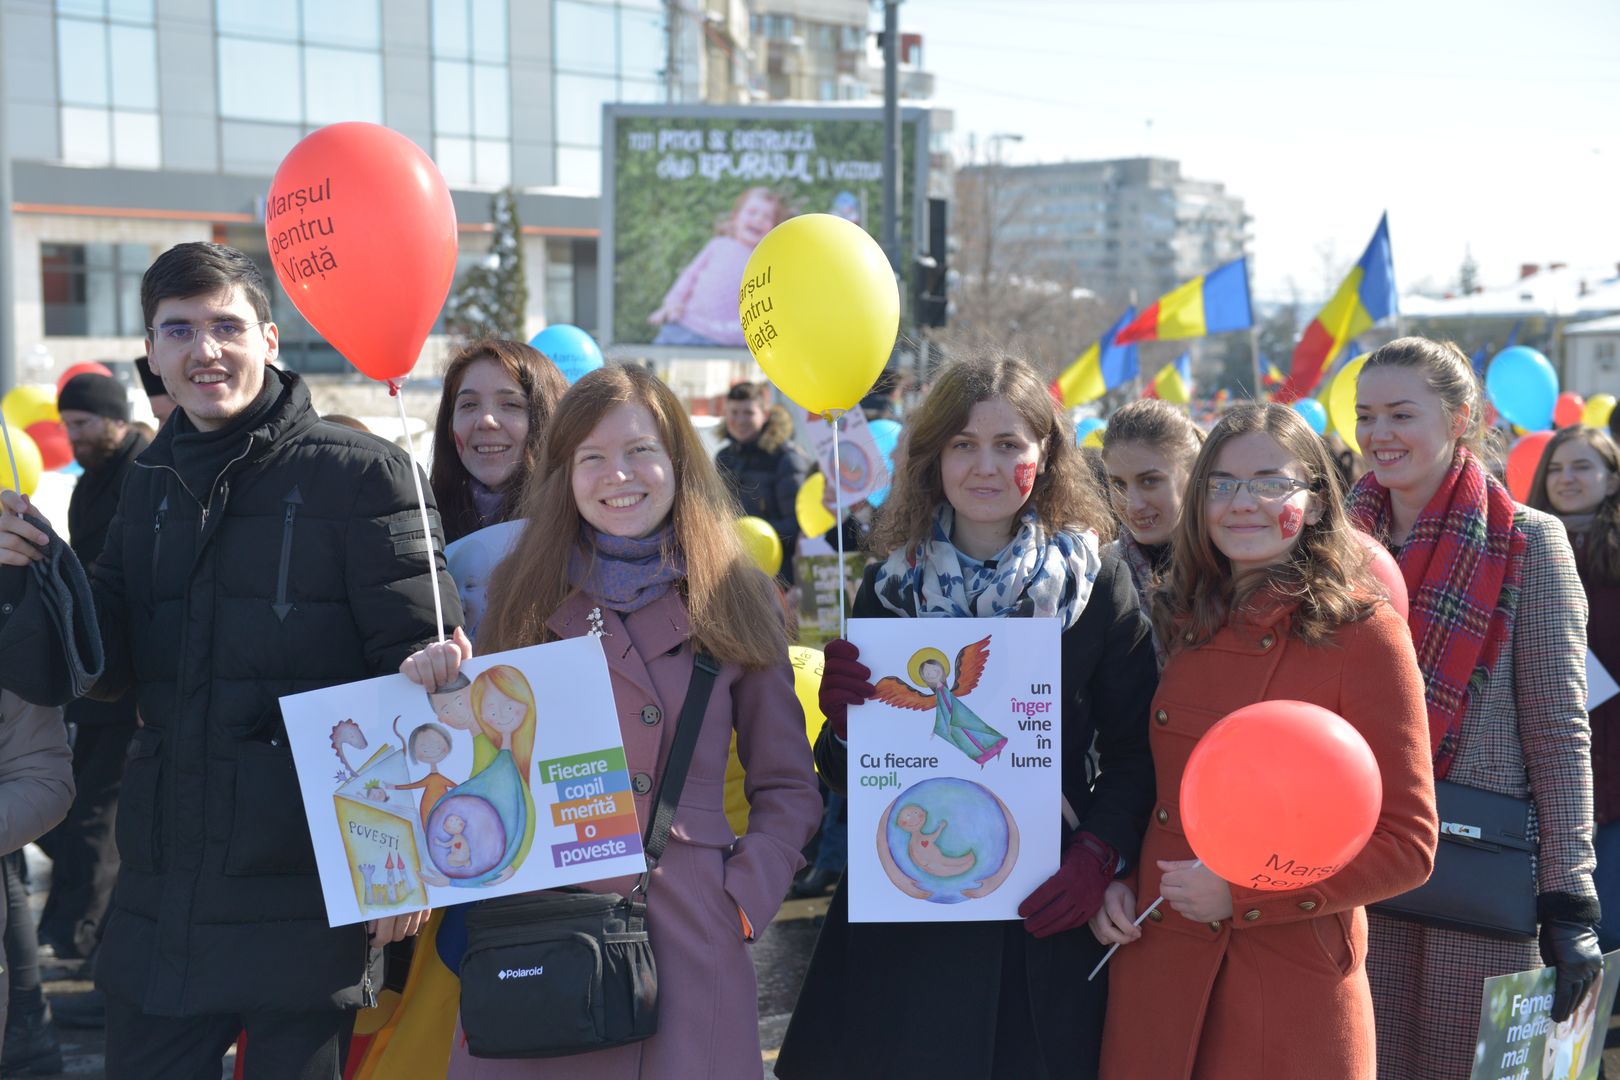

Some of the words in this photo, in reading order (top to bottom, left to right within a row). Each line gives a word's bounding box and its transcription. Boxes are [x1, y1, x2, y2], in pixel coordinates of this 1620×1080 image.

[267, 177, 331, 224] Marșul
[271, 216, 334, 261] pentru
[281, 245, 338, 283] Viață
[739, 265, 771, 305] arșul
[741, 297, 773, 331] entru
[1030, 683, 1052, 695] un
[1011, 698, 1052, 716] înger
[1017, 717, 1052, 731] vine
[1036, 734, 1052, 749] în
[548, 759, 608, 781] Fiecare
[860, 754, 880, 768] Cu
[884, 753, 938, 768] fiecare
[1011, 753, 1052, 768] lume
[565, 777, 604, 800] copil
[860, 772, 902, 790] copil,
[560, 795, 617, 822] merită
[584, 824, 597, 838] o
[560, 840, 626, 867] poveste
[506, 965, 543, 979] Polaroid
[1511, 993, 1554, 1017] Feme
[1500, 1042, 1530, 1069] mai
